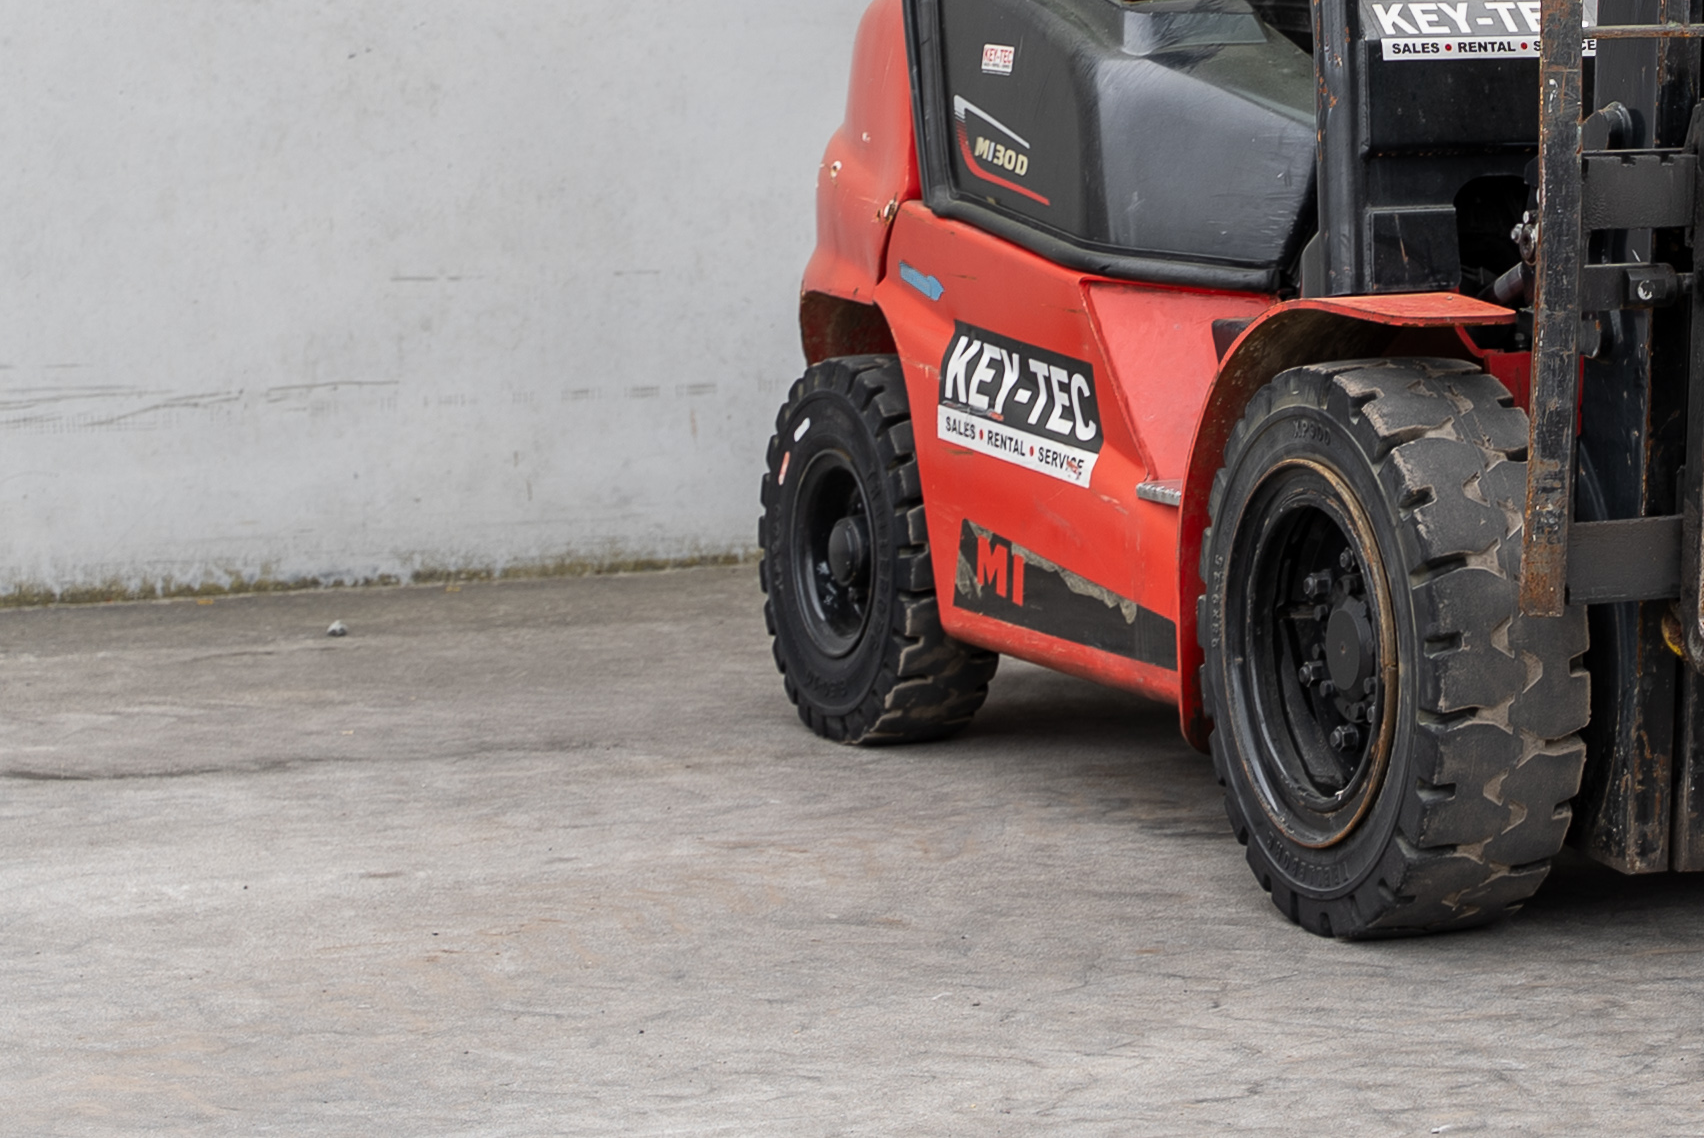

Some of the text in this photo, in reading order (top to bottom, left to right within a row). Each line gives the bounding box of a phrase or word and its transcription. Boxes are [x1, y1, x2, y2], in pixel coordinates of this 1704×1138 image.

[1372, 1, 1589, 35] KEY-TE
[1392, 41, 1516, 54] SALES RENTAL
[944, 335, 1097, 442] KEY-TEC
[945, 415, 976, 441] SALES
[987, 429, 1026, 457] RENTAL
[976, 535, 1025, 608] MI
